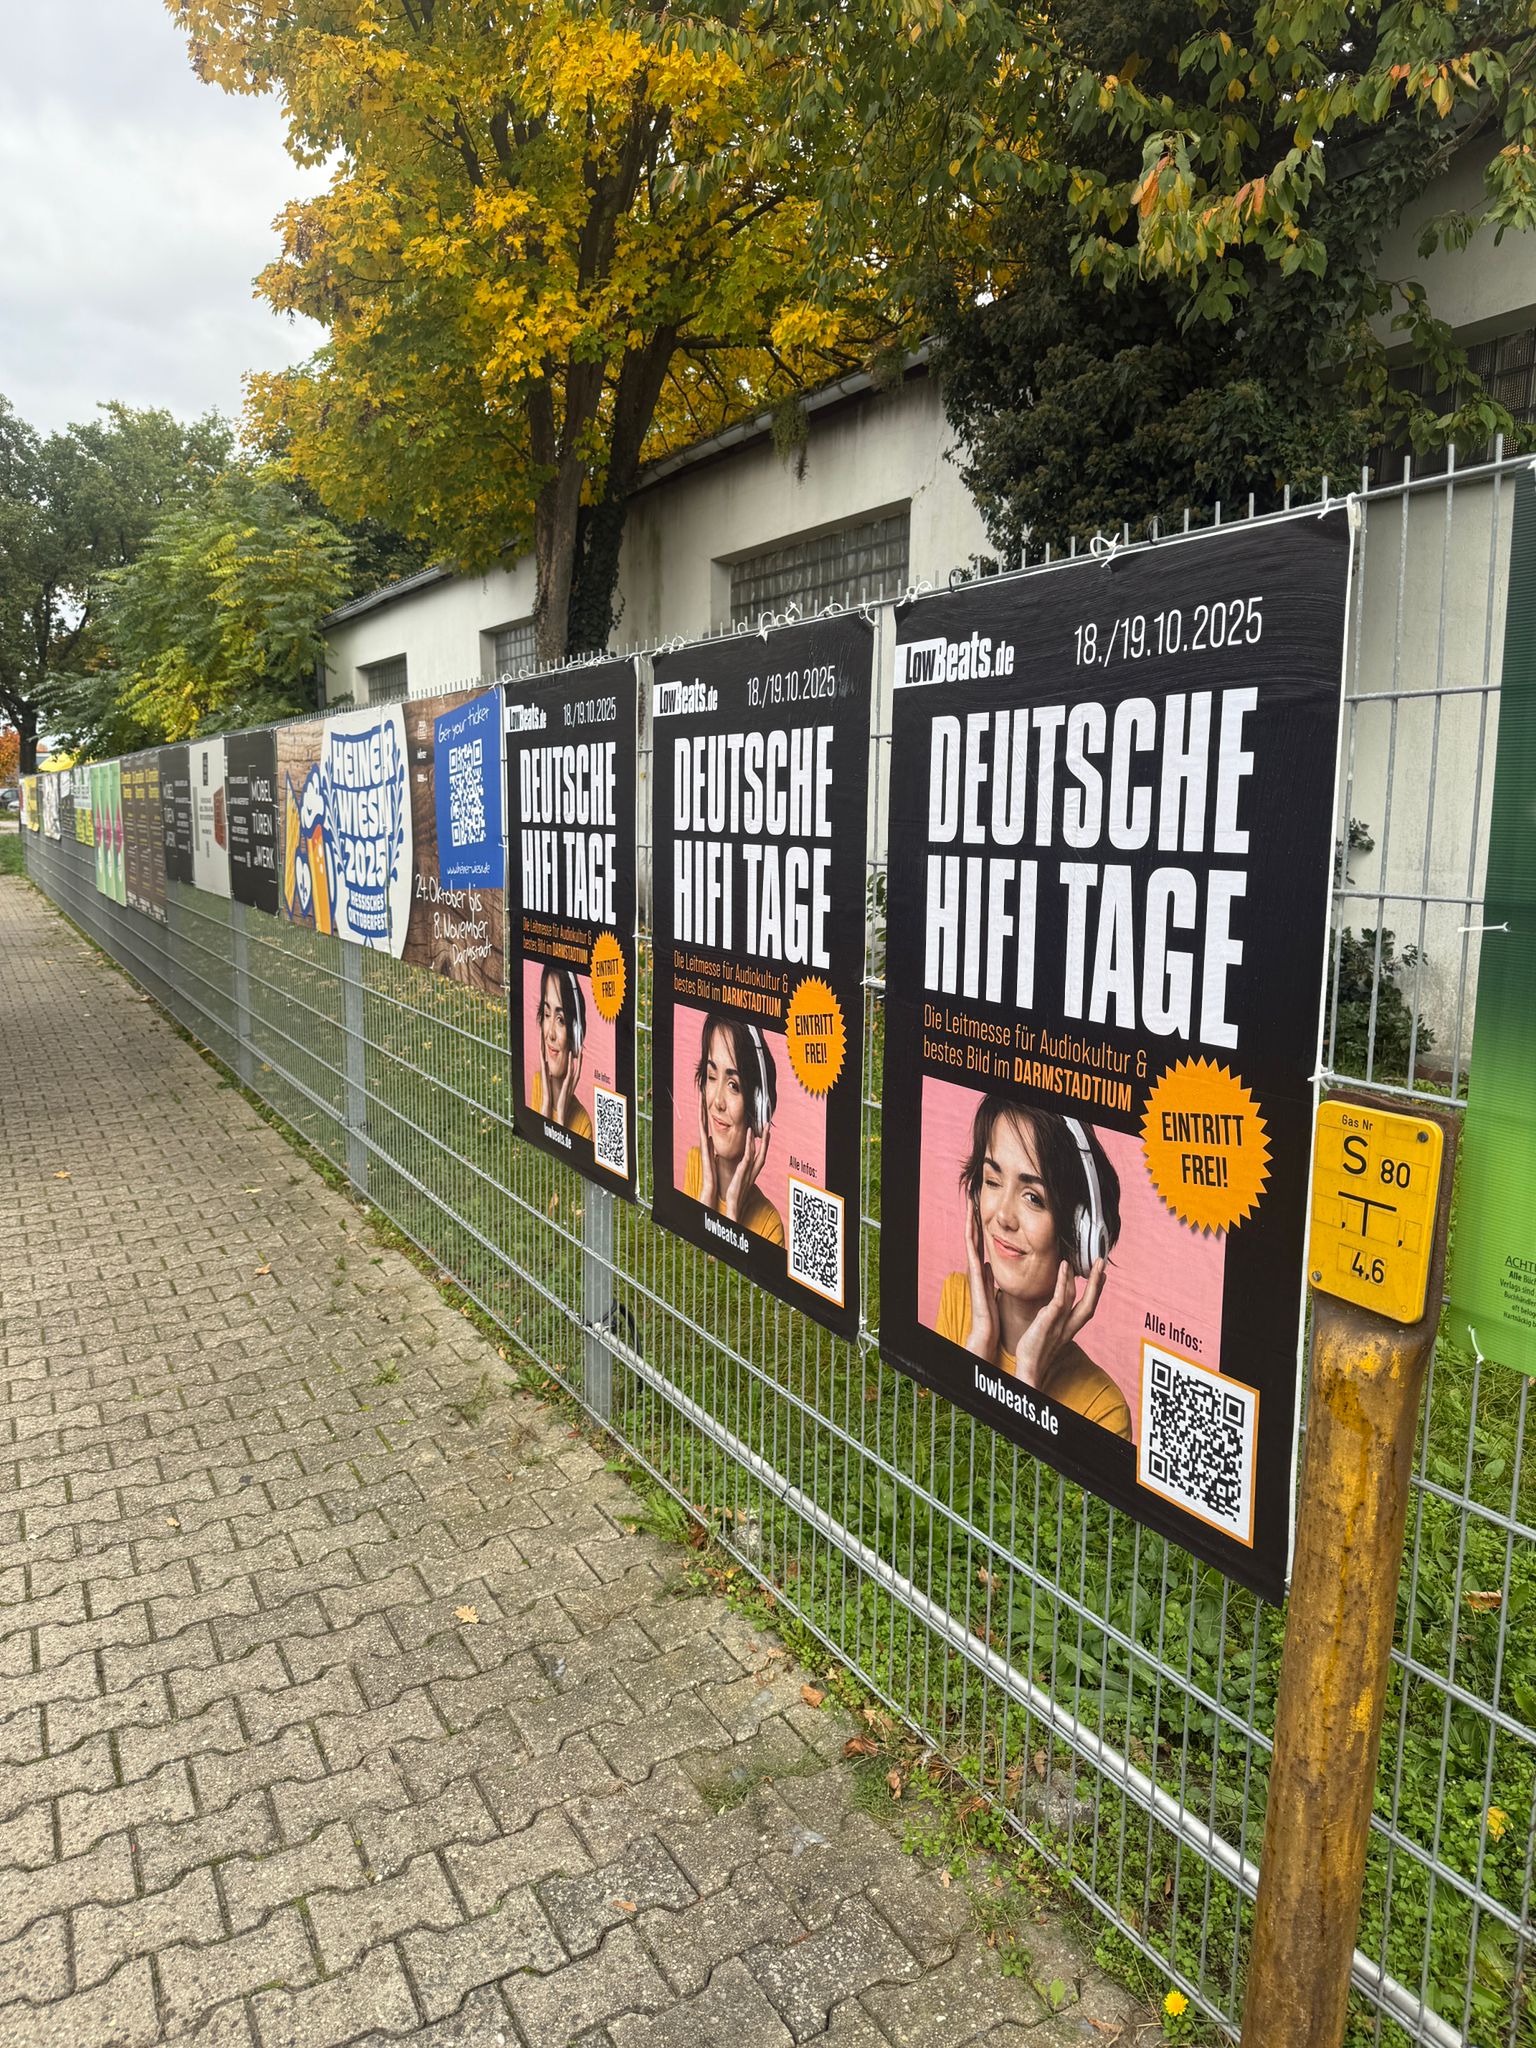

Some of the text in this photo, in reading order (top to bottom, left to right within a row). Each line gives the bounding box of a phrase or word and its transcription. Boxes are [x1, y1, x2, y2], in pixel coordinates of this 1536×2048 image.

[905, 631, 1014, 684] LowBeats.de
[1074, 596, 1264, 668] 18./19.10.2025
[659, 677, 718, 714] LowBeats.de
[747, 665, 836, 709] 18./19.10.2025
[333, 728, 395, 788] HEINER
[673, 725, 834, 837] DEUTSCHE
[928, 686, 1258, 854] DEUTSCHE
[520, 742, 616, 826] DEUTSCHE
[336, 783, 394, 838] WIESN
[345, 838, 388, 887] 2025
[521, 829, 616, 925] HIFI TAGE
[468, 881, 483, 912] bis
[673, 839, 831, 970] HIFI TAGE
[673, 950, 789, 993] Die Leitmesse für Audiokultur &
[924, 854, 1247, 1049] HIFI TAGE
[673, 972, 782, 1018] bestes Bild im DARMSTADTIUM
[795, 1013, 834, 1036] EINTRITT
[924, 1003, 1148, 1079] Die Leitmesse für Audiokultur &
[804, 1042, 827, 1064] FREI!
[923, 1034, 1132, 1113] bestes Bild im DARMSTADTIUM
[1161, 1111, 1244, 1147] EINTRITT
[1342, 1114, 1373, 1131] Gas Nr
[788, 1155, 817, 1179] Alle Infos:
[1181, 1153, 1228, 1188] FREI!
[1343, 1135, 1410, 1188] S 80
[704, 1212, 749, 1253] lowbeats.de
[1144, 1312, 1203, 1353] Alle Infos:
[974, 1365, 1059, 1436] lowbeats.de
